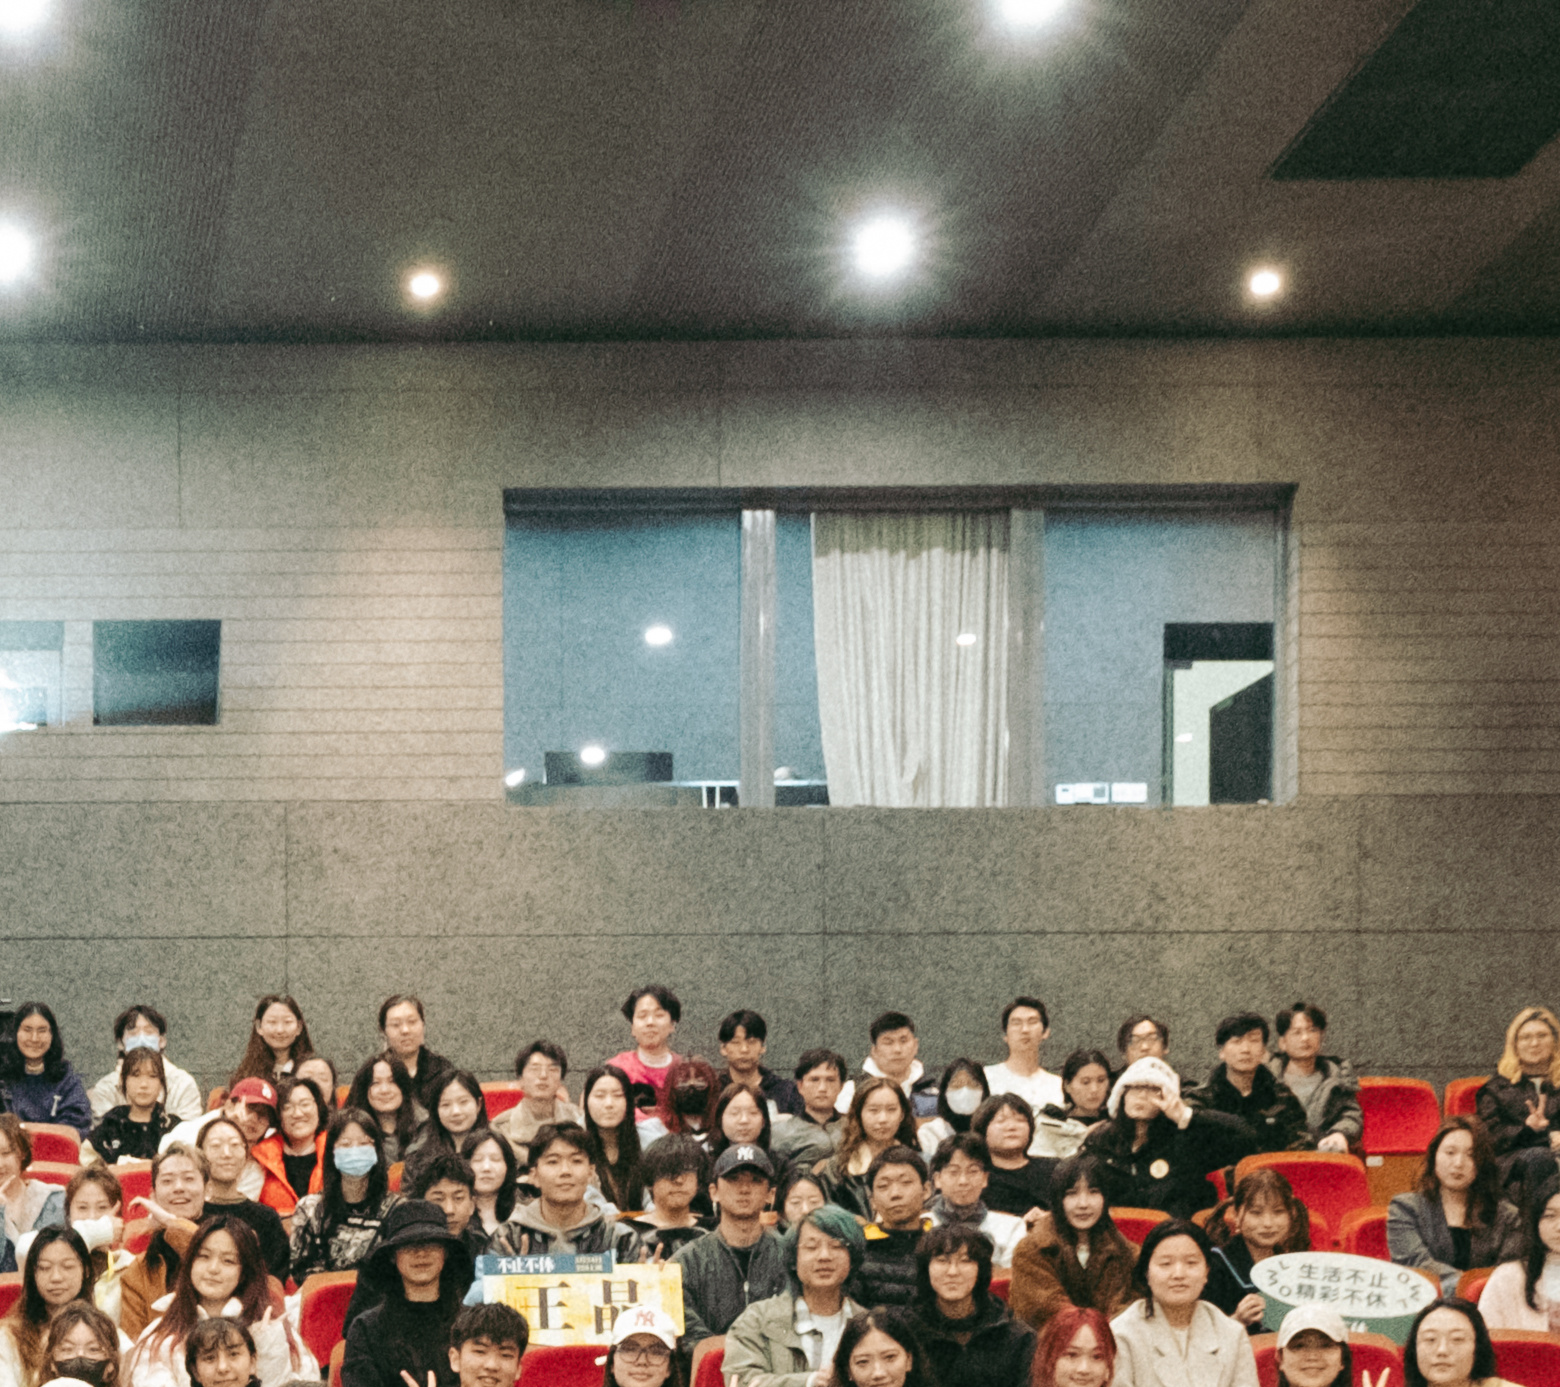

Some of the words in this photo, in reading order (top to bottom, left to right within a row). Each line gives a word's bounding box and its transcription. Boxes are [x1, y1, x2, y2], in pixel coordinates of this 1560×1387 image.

[1297, 1263, 1389, 1290] 生活不止
[1294, 1283, 1388, 1308] 精彩不休
